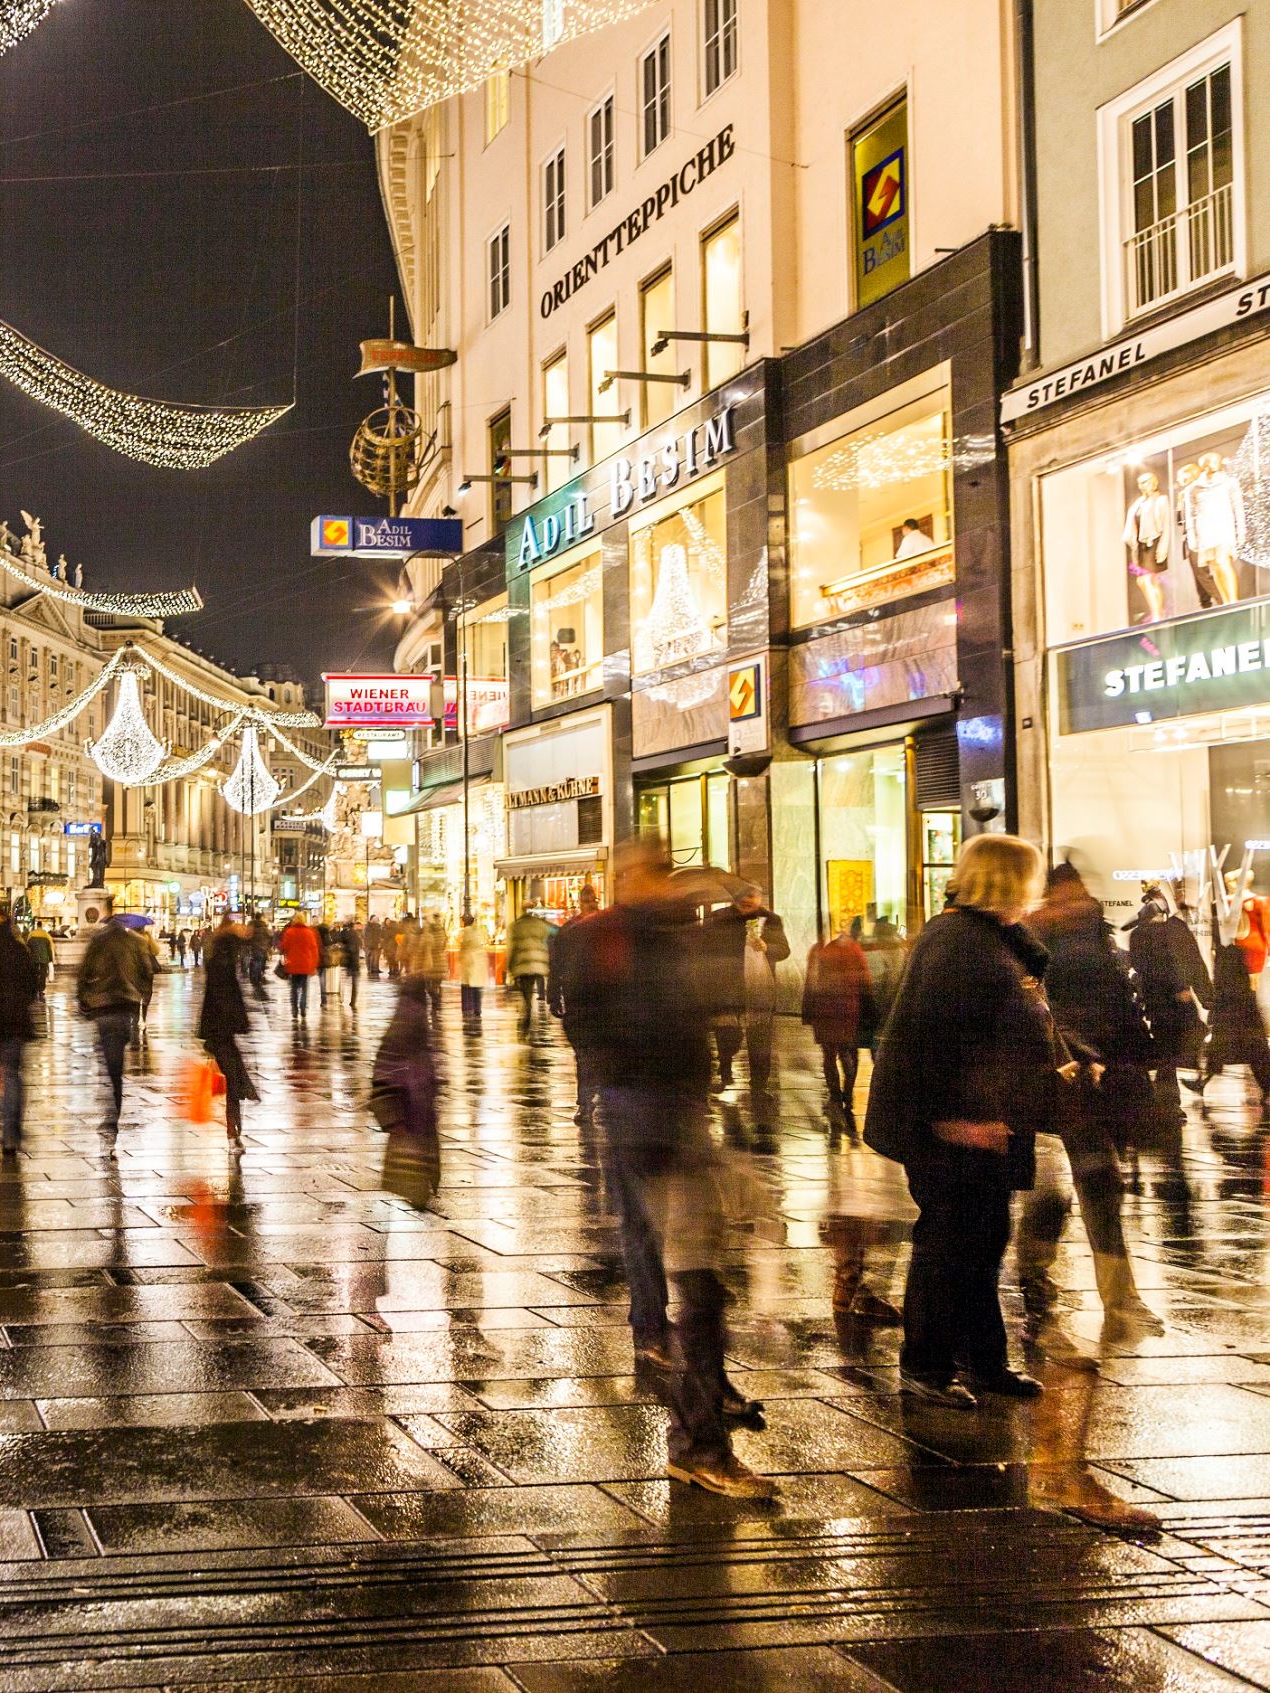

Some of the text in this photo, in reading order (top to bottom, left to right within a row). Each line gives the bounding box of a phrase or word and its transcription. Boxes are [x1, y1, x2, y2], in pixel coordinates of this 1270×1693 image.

[540, 123, 736, 319] ORIENTTEPPICHE
[1026, 343, 1146, 409] STEFANEL
[516, 406, 736, 570] ADIL BESIM
[358, 525, 412, 547] BESIM
[376, 519, 412, 535] ADIL
[350, 688, 409, 699] WIENER
[334, 701, 427, 713] STADTBRÄU
